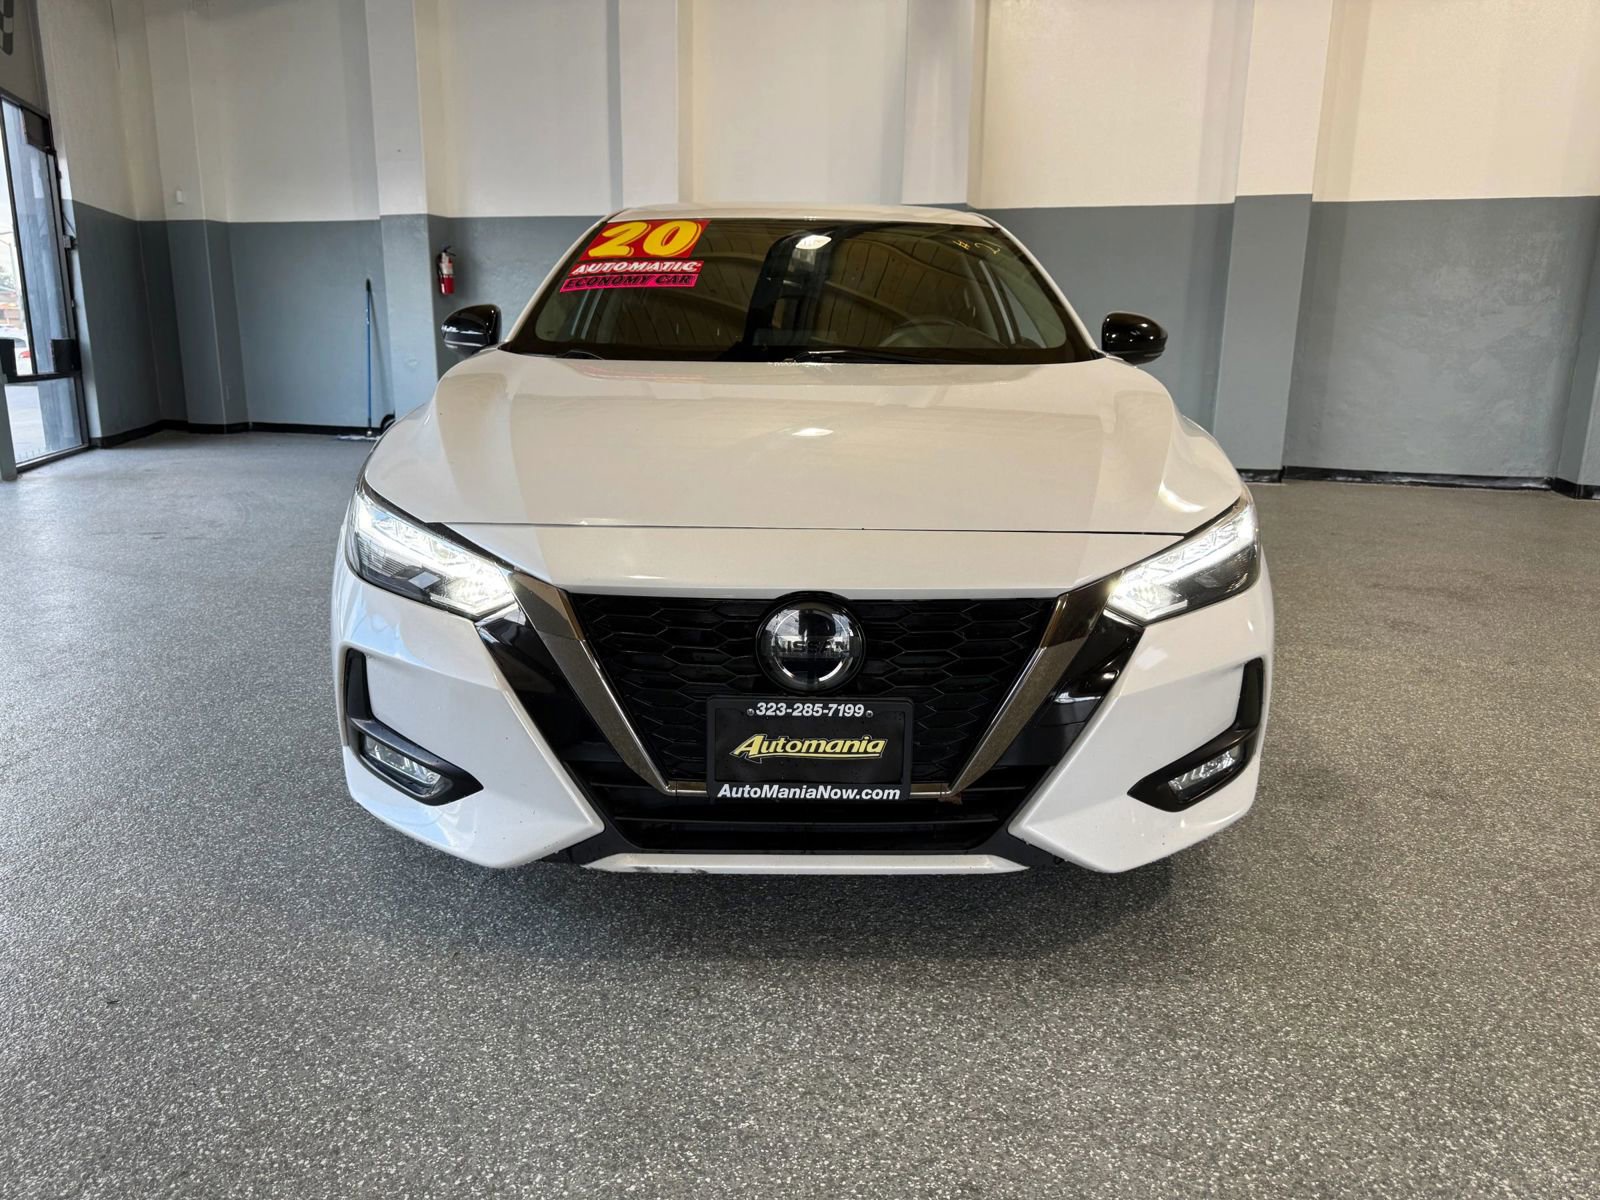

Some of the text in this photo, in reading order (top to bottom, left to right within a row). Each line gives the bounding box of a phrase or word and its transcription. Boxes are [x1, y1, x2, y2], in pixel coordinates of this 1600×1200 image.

[588, 220, 702, 258] 20
[571, 261, 701, 275] AUTOMATIC
[564, 275, 694, 288] ECONOMY CAR
[755, 702, 865, 717] 323-285-7199
[731, 734, 887, 758] Automania
[717, 783, 901, 801] AutoManiaNow.com
